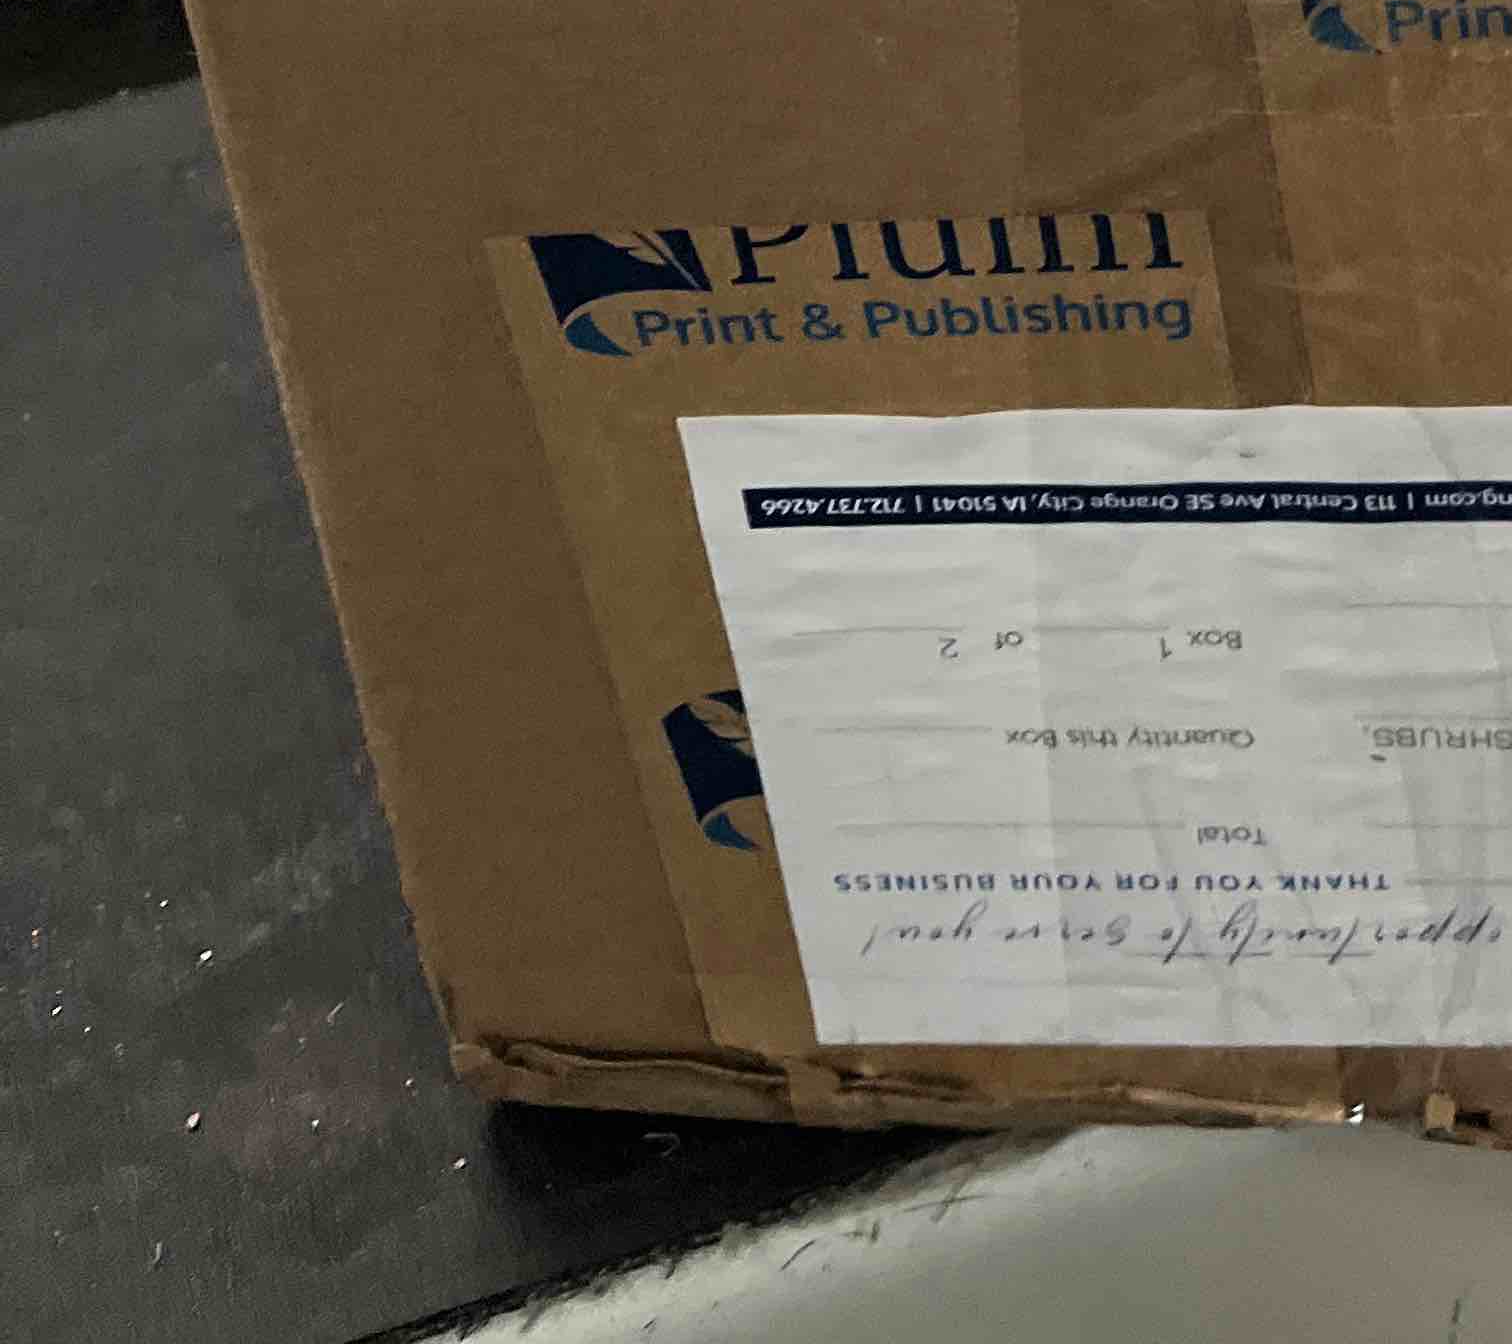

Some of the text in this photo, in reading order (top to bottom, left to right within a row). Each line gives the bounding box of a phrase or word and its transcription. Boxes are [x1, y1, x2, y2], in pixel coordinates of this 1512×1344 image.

[632, 293, 1193, 350] Print & Publishing
[761, 496, 905, 515] 712.737.4266
[932, 496, 996, 513] 51041
[1002, 495, 1026, 512] IA
[1032, 492, 1084, 513] City,
[1091, 490, 1179, 511] Orange
[1186, 494, 1215, 511] SE
[1220, 493, 1265, 510] Ave
[1273, 493, 1357, 511] Central
[1364, 495, 1397, 511] 113
[939, 630, 1243, 661] Box 1 of 2
[1005, 725, 1255, 750] Quantity this Box
[1197, 825, 1268, 847] Total
[832, 873, 1390, 891] THANK YOU FOR YOUR BUSINESS
[861, 899, 988, 957] you!
[1000, 915, 1131, 955] serve
[1219, 903, 1501, 965] opportunity
